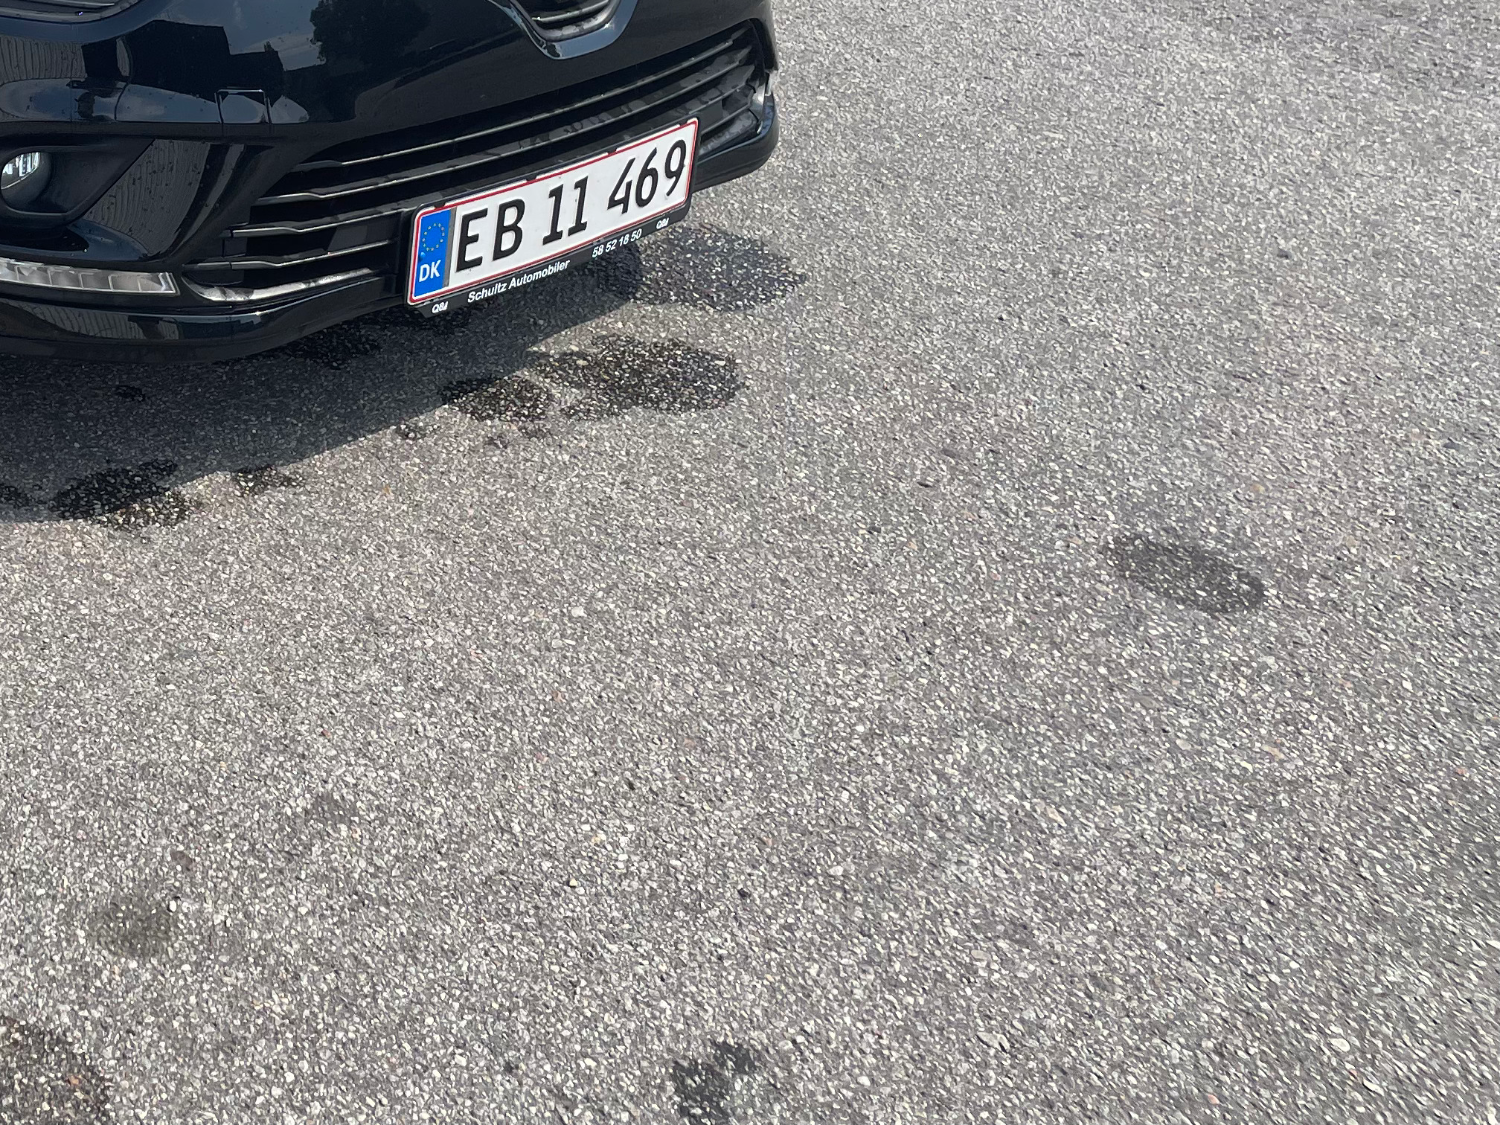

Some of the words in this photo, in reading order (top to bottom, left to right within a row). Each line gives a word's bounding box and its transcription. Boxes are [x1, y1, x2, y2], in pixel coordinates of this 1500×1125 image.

[456, 198, 525, 272] EB
[542, 175, 589, 245] 11
[606, 139, 687, 215] 469
[592, 244, 604, 258] 58
[605, 239, 617, 253] 52
[618, 234, 630, 246] 18
[631, 228, 642, 241] 50
[418, 260, 441, 282] DK
[467, 282, 507, 303] Schultz
[508, 260, 570, 290] Automobiler
